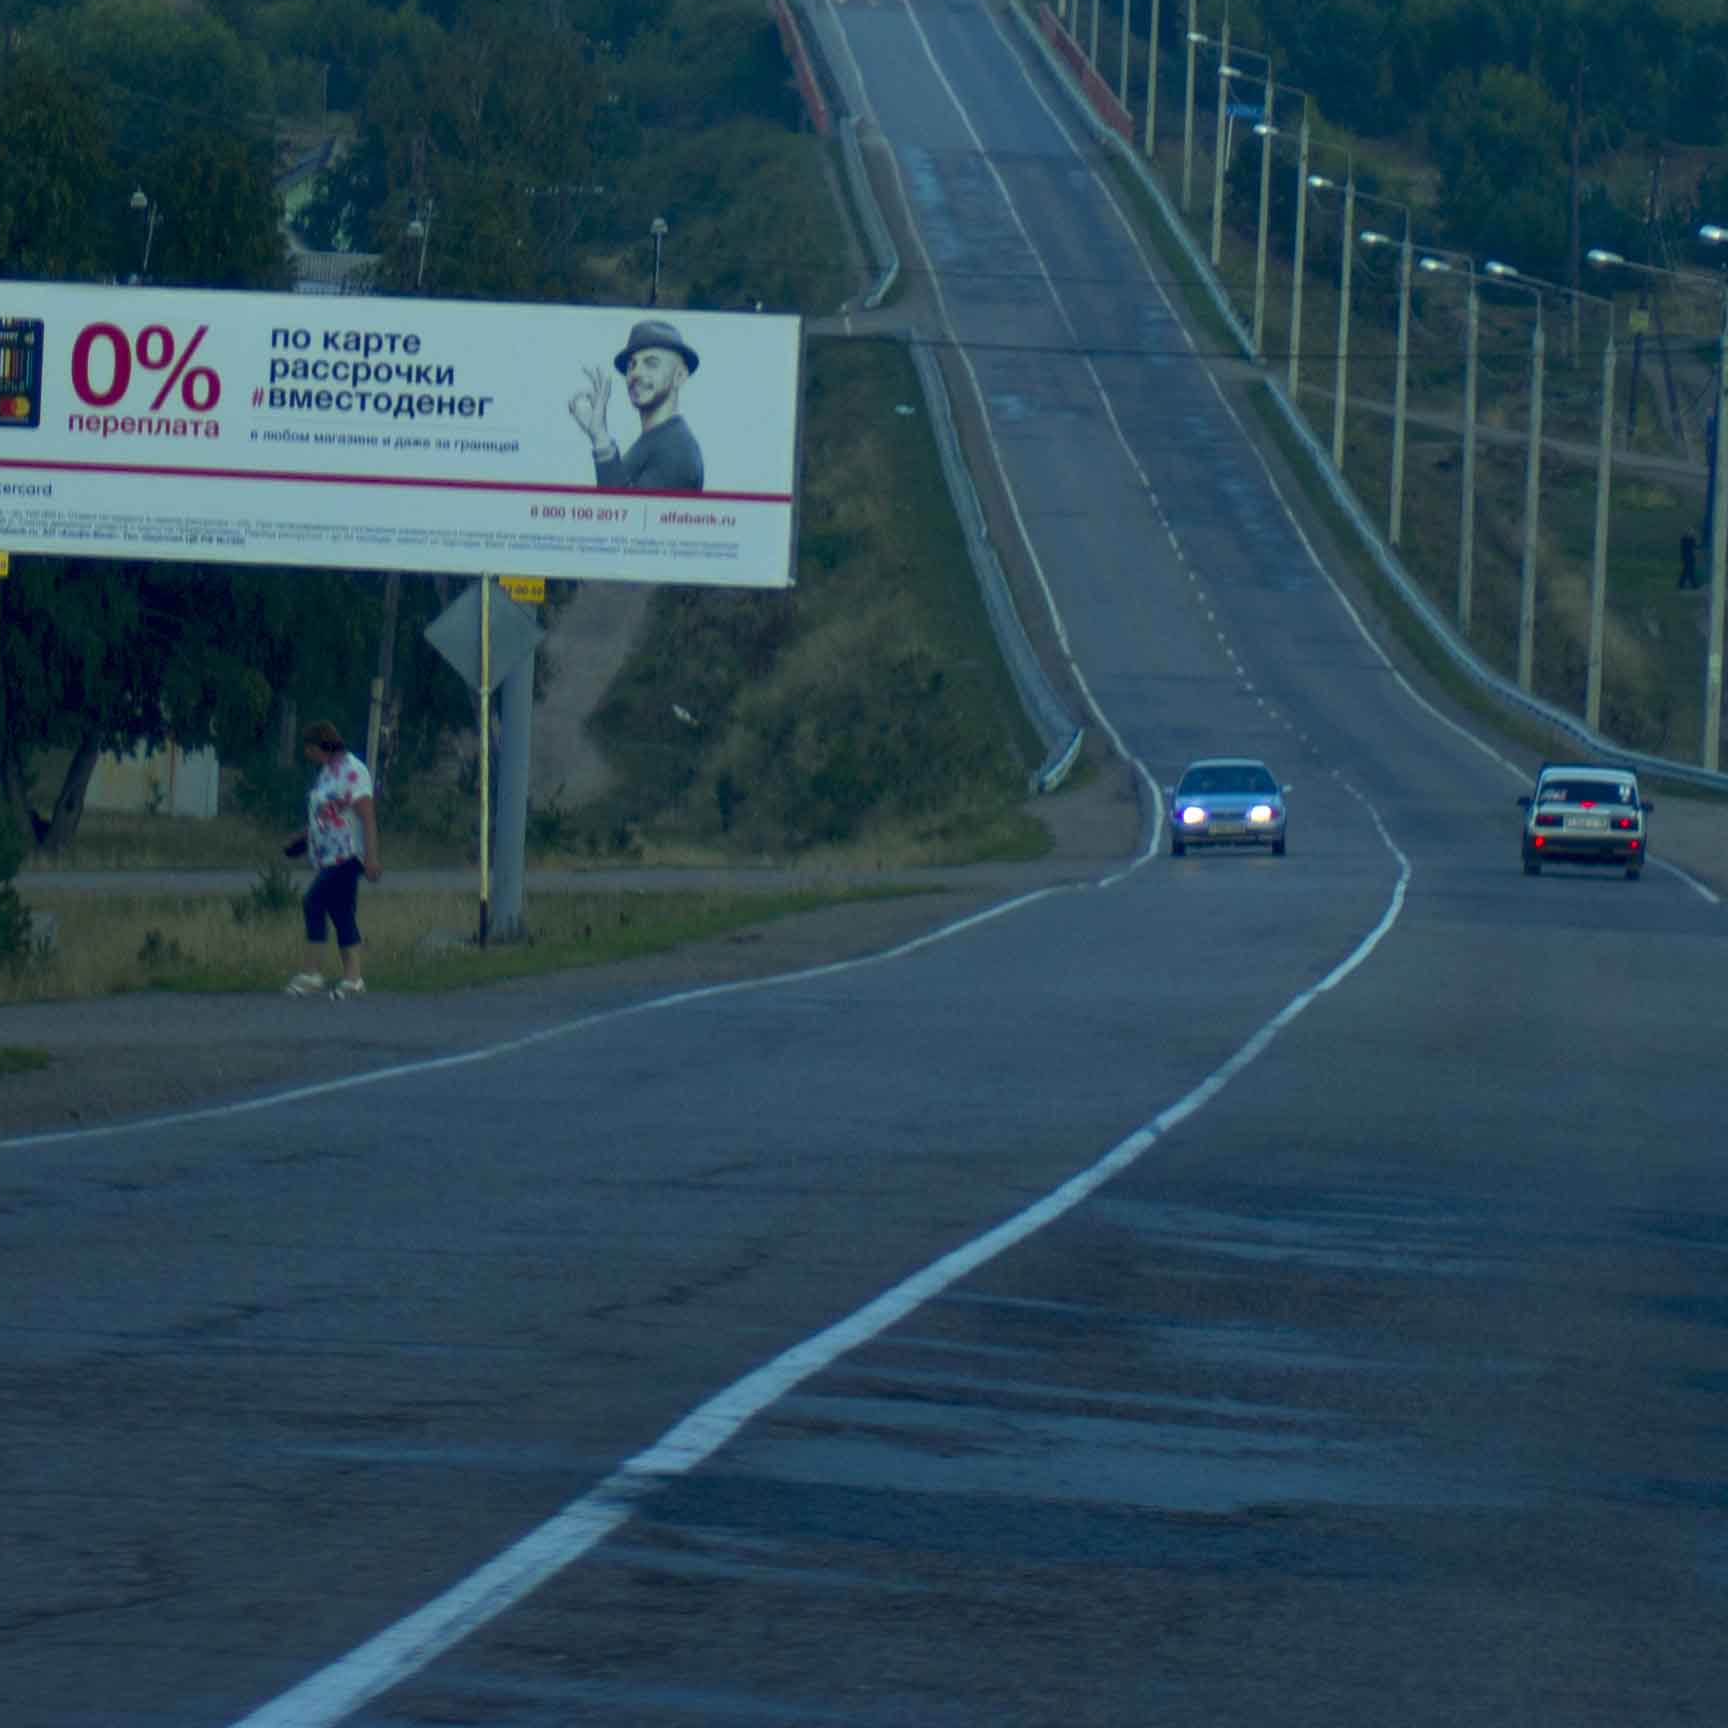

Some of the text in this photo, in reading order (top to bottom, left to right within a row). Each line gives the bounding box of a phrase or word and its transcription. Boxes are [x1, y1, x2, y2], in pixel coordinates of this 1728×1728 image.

[271, 328, 422, 358] по карте
[71, 321, 221, 413] 0%
[269, 357, 455, 387] рассрочки
[251, 386, 494, 419] #вместоденег
[68, 413, 220, 438] переплата
[263, 430, 310, 443] любом
[314, 432, 378, 446] магазине
[394, 437, 431, 450] даже
[435, 439, 451, 450] за
[454, 439, 520, 454] границей
[541, 505, 566, 520] 800
[571, 506, 593, 521] 100
[659, 510, 736, 528] alfabank.ru
